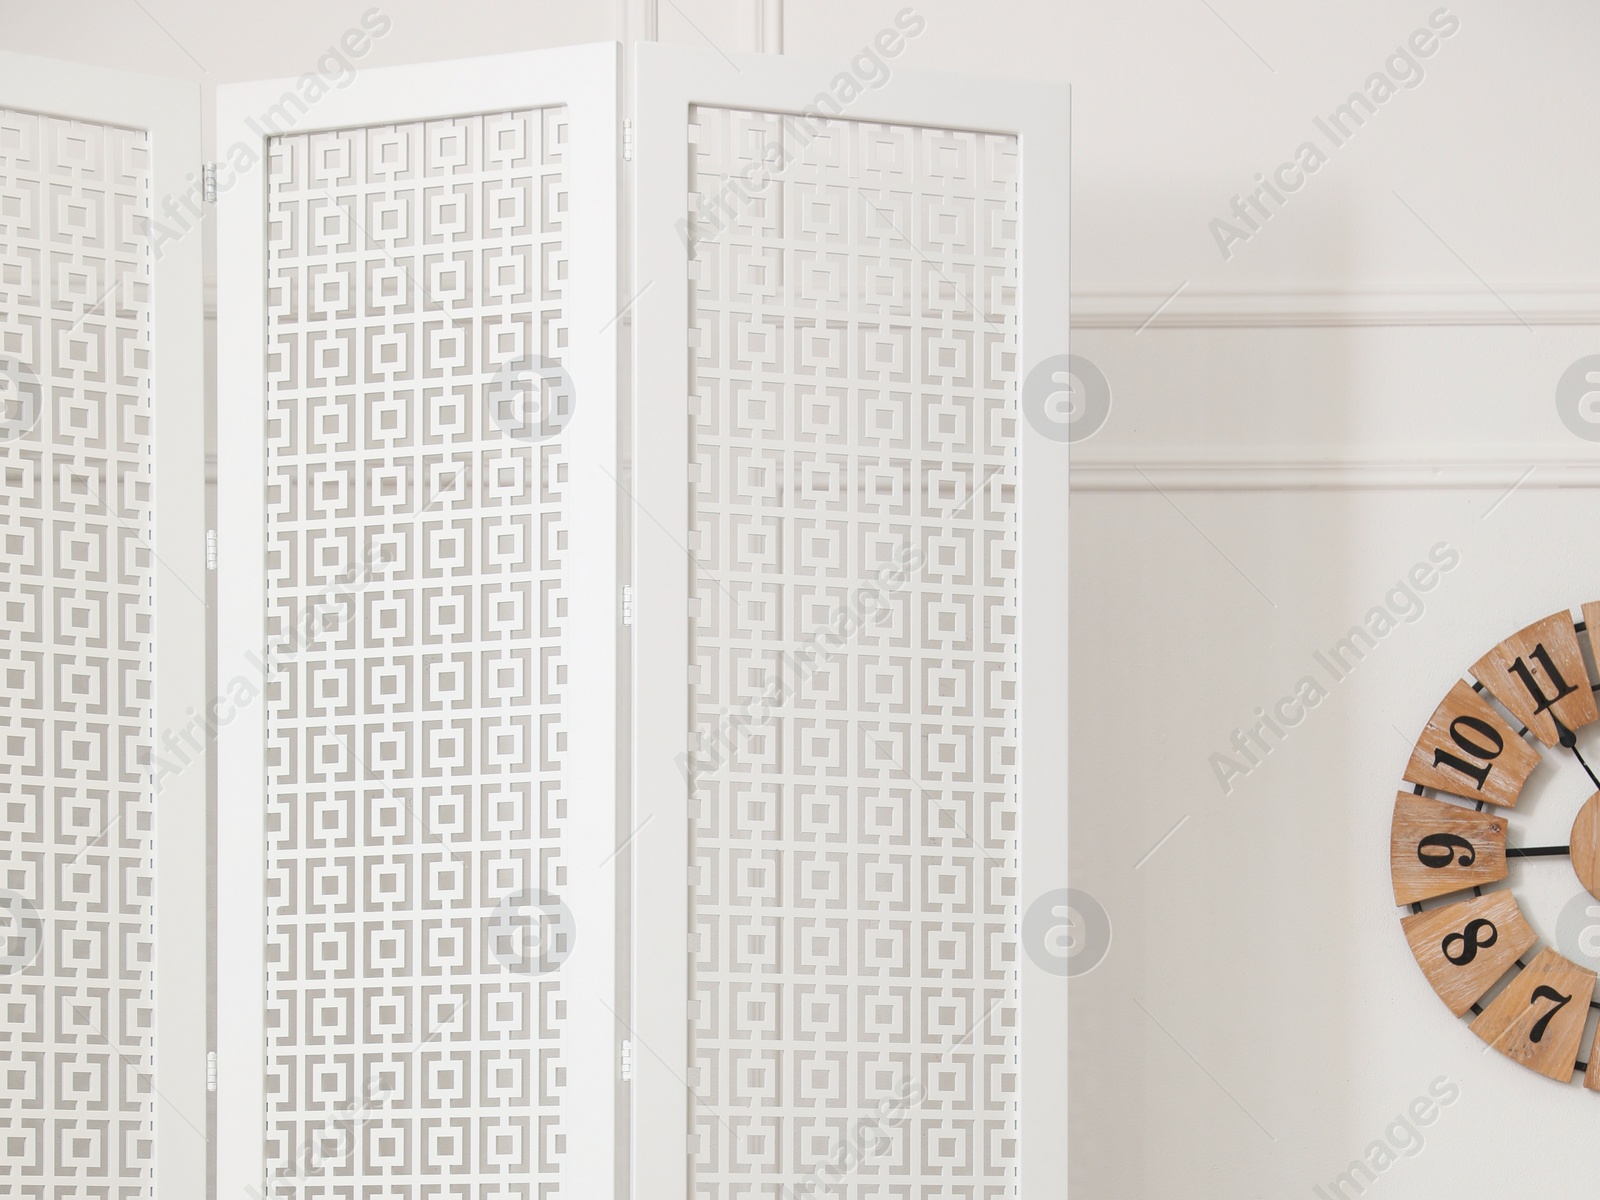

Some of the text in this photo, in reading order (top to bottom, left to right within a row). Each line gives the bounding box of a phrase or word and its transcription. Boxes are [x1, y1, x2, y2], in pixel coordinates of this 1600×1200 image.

[1507, 643, 1579, 716] 11
[1432, 715, 1504, 791] 10
[1417, 833, 1476, 868] 9
[1441, 918, 1498, 966] 8
[1529, 985, 1572, 1043] 7
